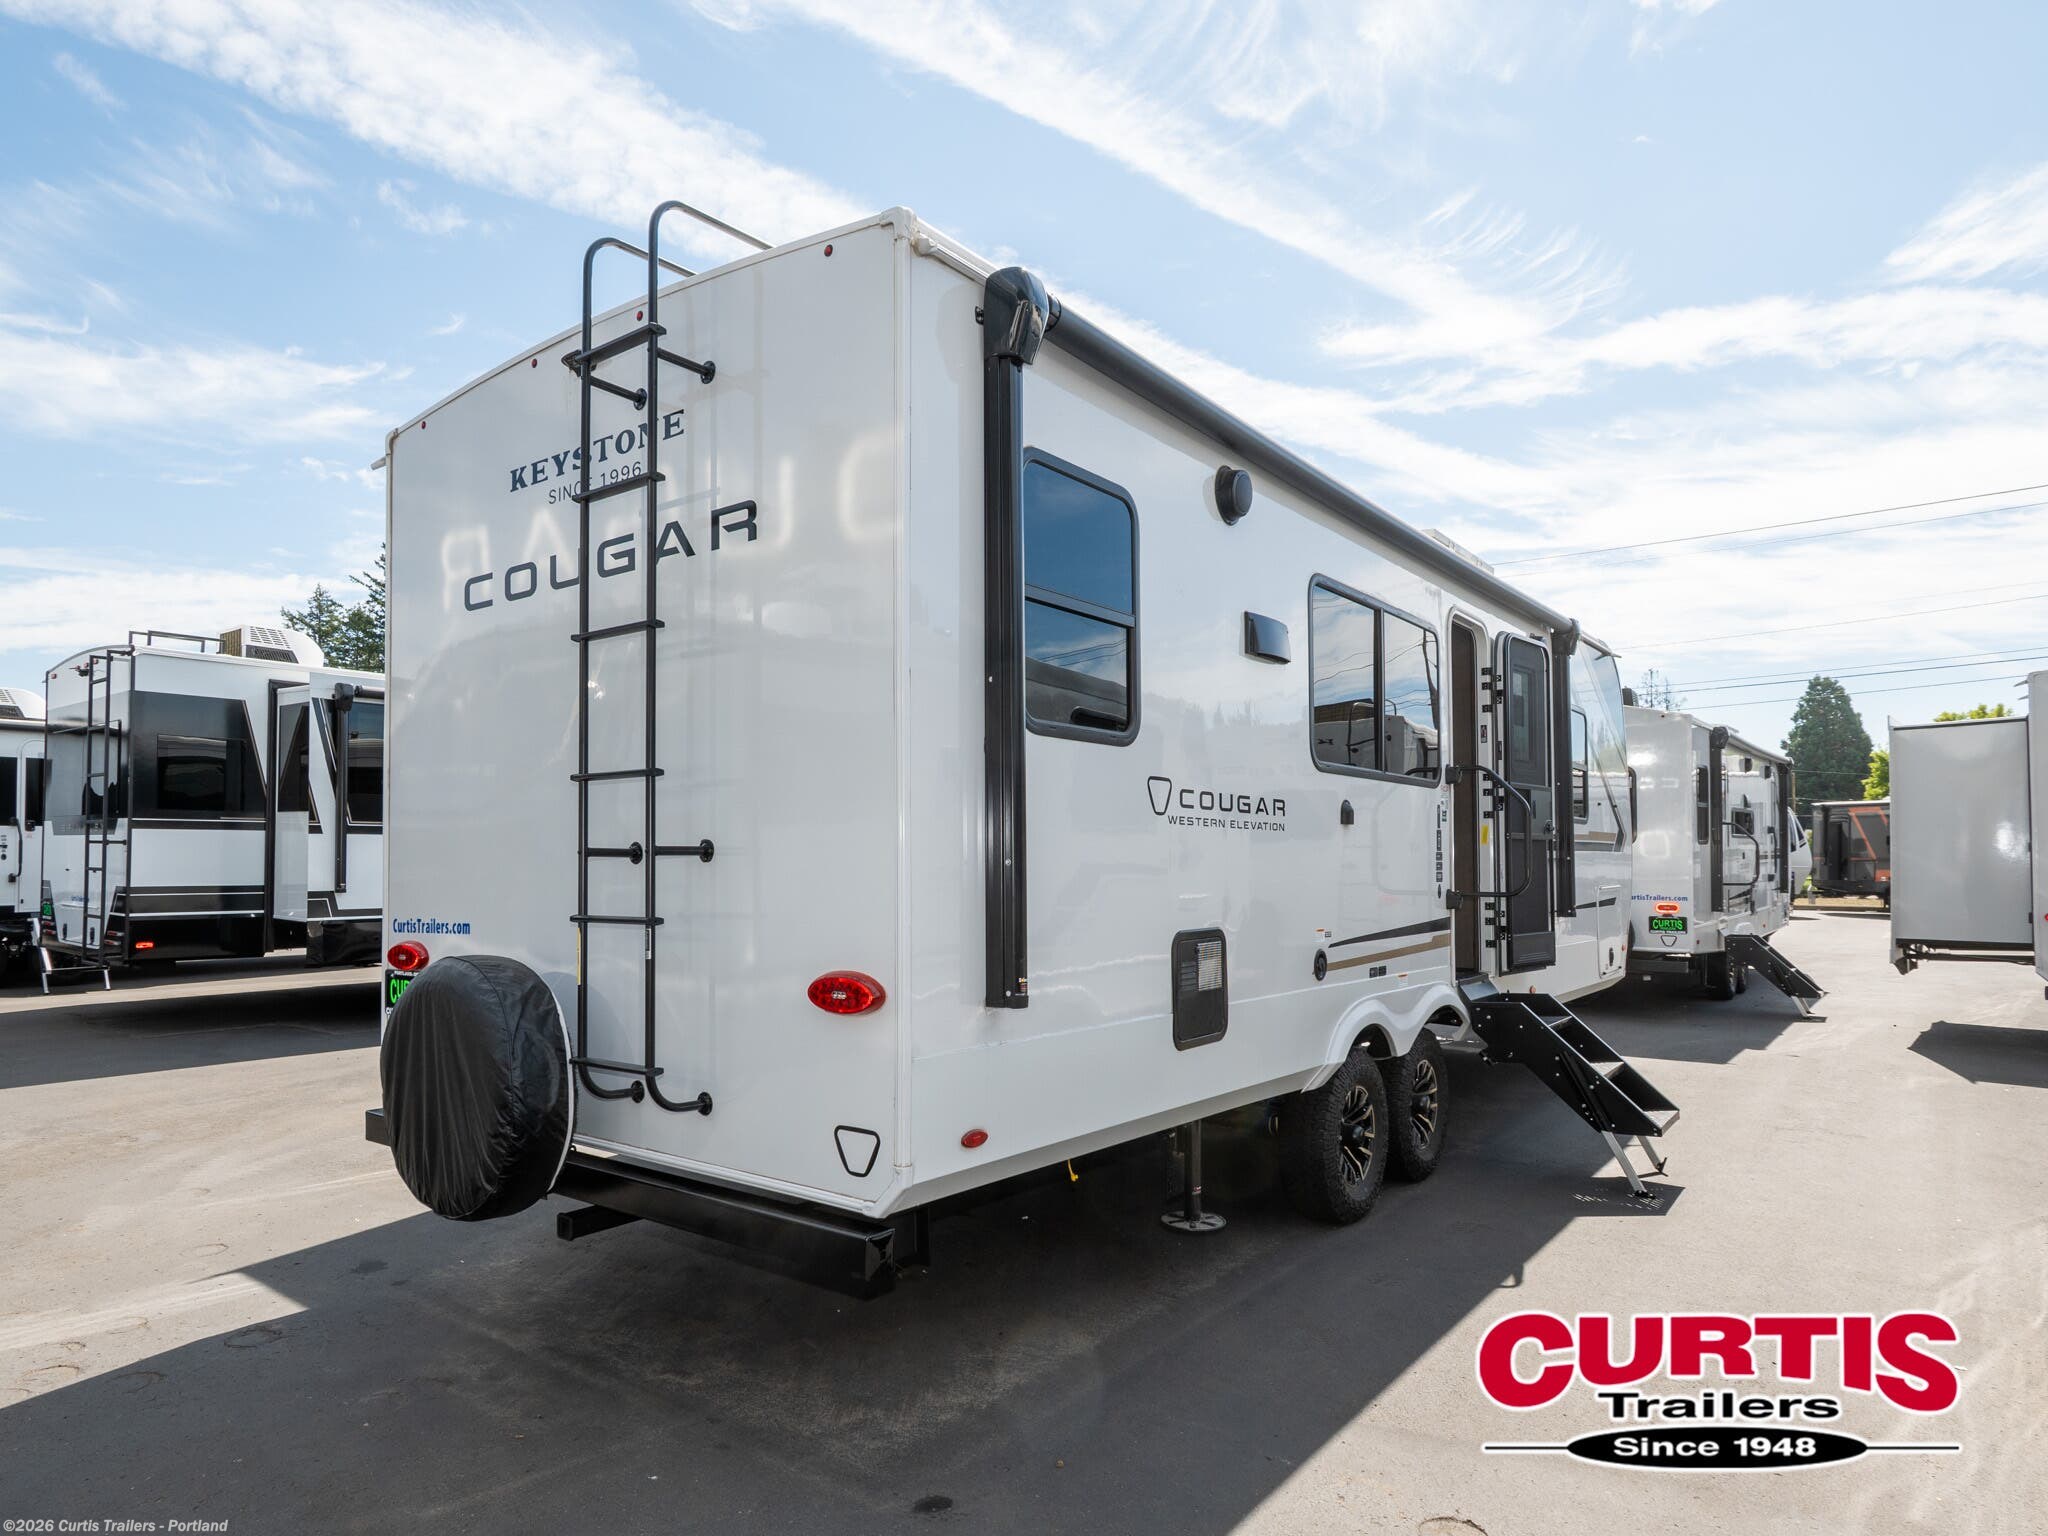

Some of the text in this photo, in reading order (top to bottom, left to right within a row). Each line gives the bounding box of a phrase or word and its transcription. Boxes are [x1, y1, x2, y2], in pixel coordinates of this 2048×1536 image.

[549, 461, 642, 504] SINC 1996
[464, 499, 758, 611] COUGAR
[1179, 789, 1286, 817] COUGAR
[1167, 815, 1285, 832] WESTERN ELEVATION
[393, 918, 471, 934] CurtisTrailers.com
[1652, 919, 1683, 930] CURTIS
